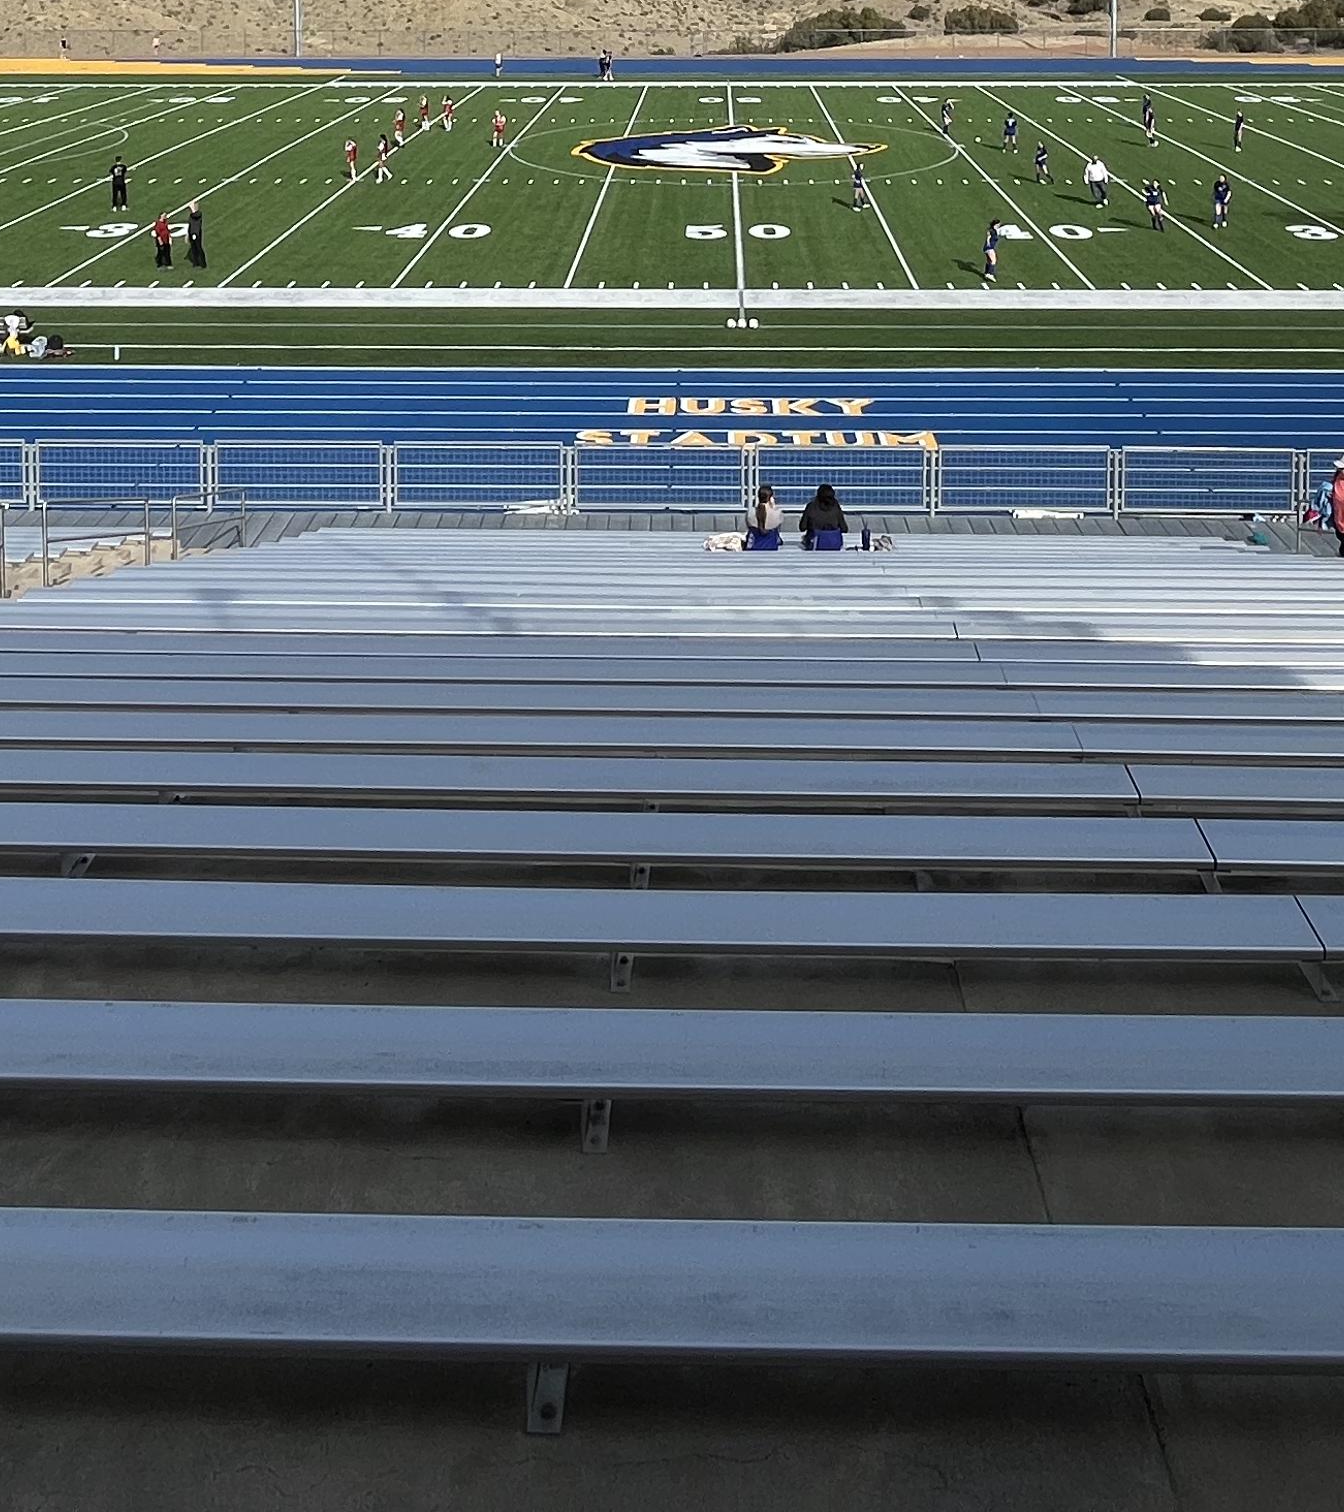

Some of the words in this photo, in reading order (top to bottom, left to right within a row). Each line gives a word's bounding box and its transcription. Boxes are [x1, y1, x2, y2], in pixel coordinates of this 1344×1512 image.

[385, 223, 492, 239] 40
[684, 223, 792, 240] 50
[997, 224, 1093, 240] 40
[628, 396, 875, 416] HUSKY
[574, 430, 939, 450] STADIUM
